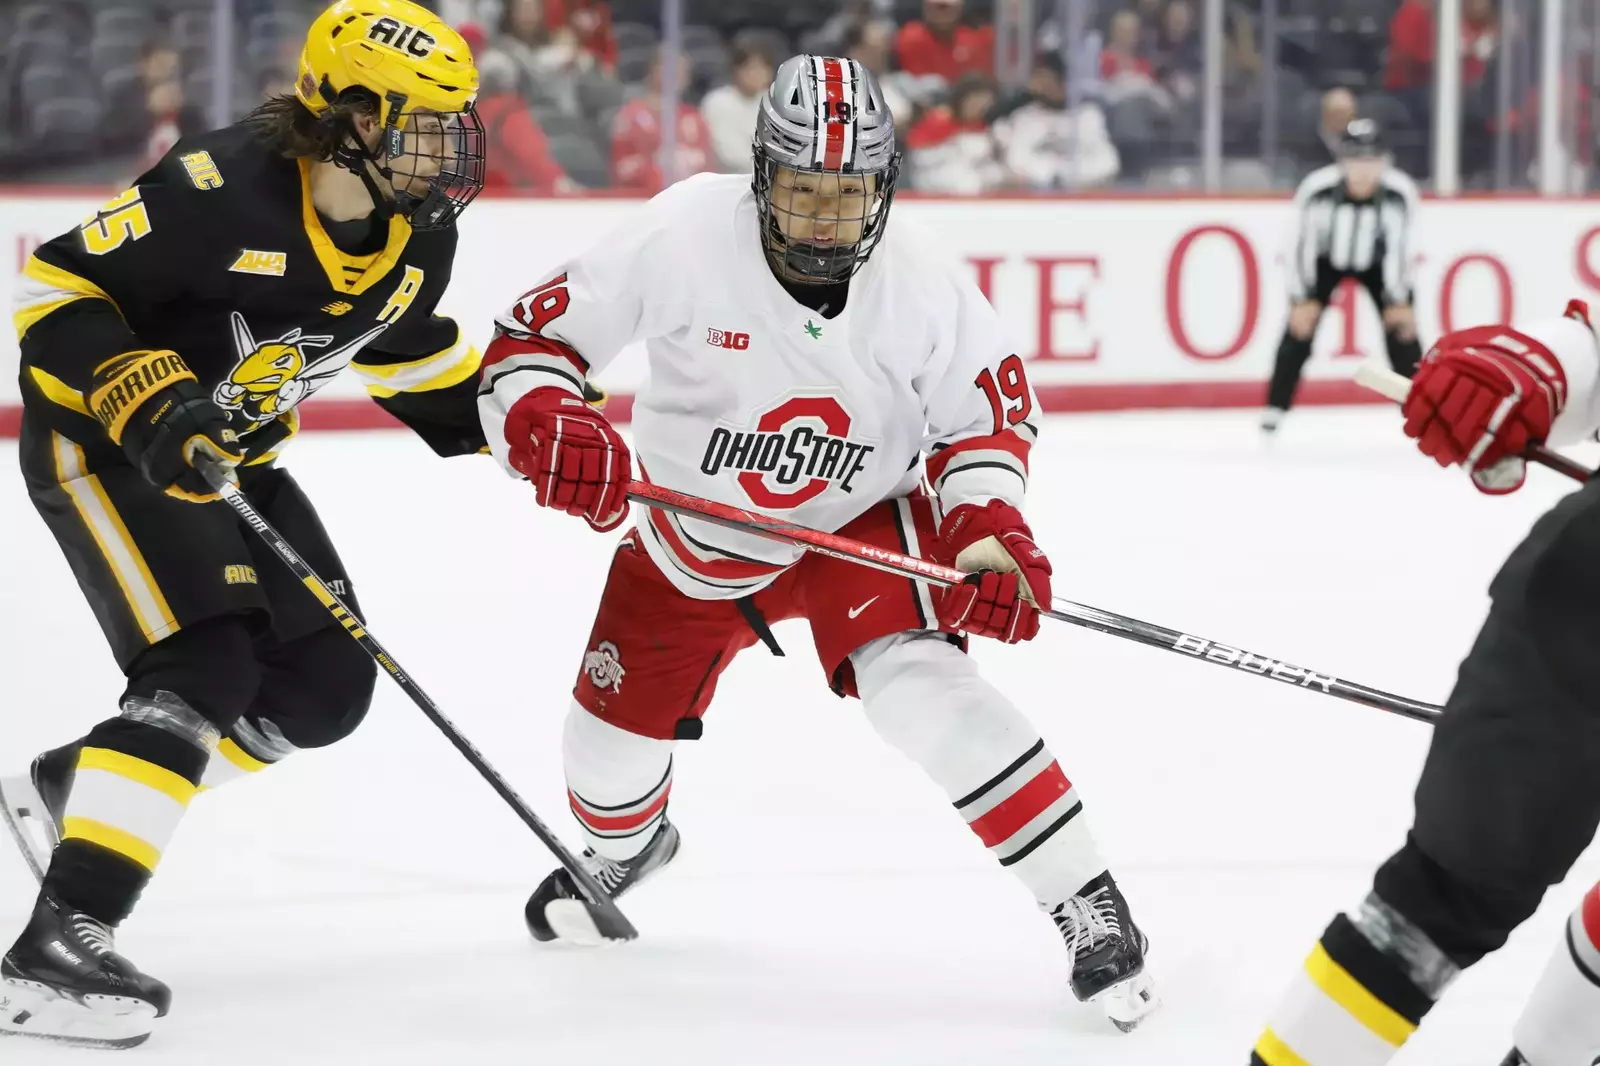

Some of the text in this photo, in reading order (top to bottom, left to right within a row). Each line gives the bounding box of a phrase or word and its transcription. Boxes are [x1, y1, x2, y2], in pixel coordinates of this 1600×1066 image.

[368, 17, 435, 58] AIC
[822, 101, 851, 124] 19
[180, 150, 224, 190] AIC
[512, 271, 570, 334] 19
[974, 354, 1031, 436] 19
[150, 399, 173, 425] COVERT
[224, 564, 257, 585] AIC
[51, 940, 82, 965] BAUER
